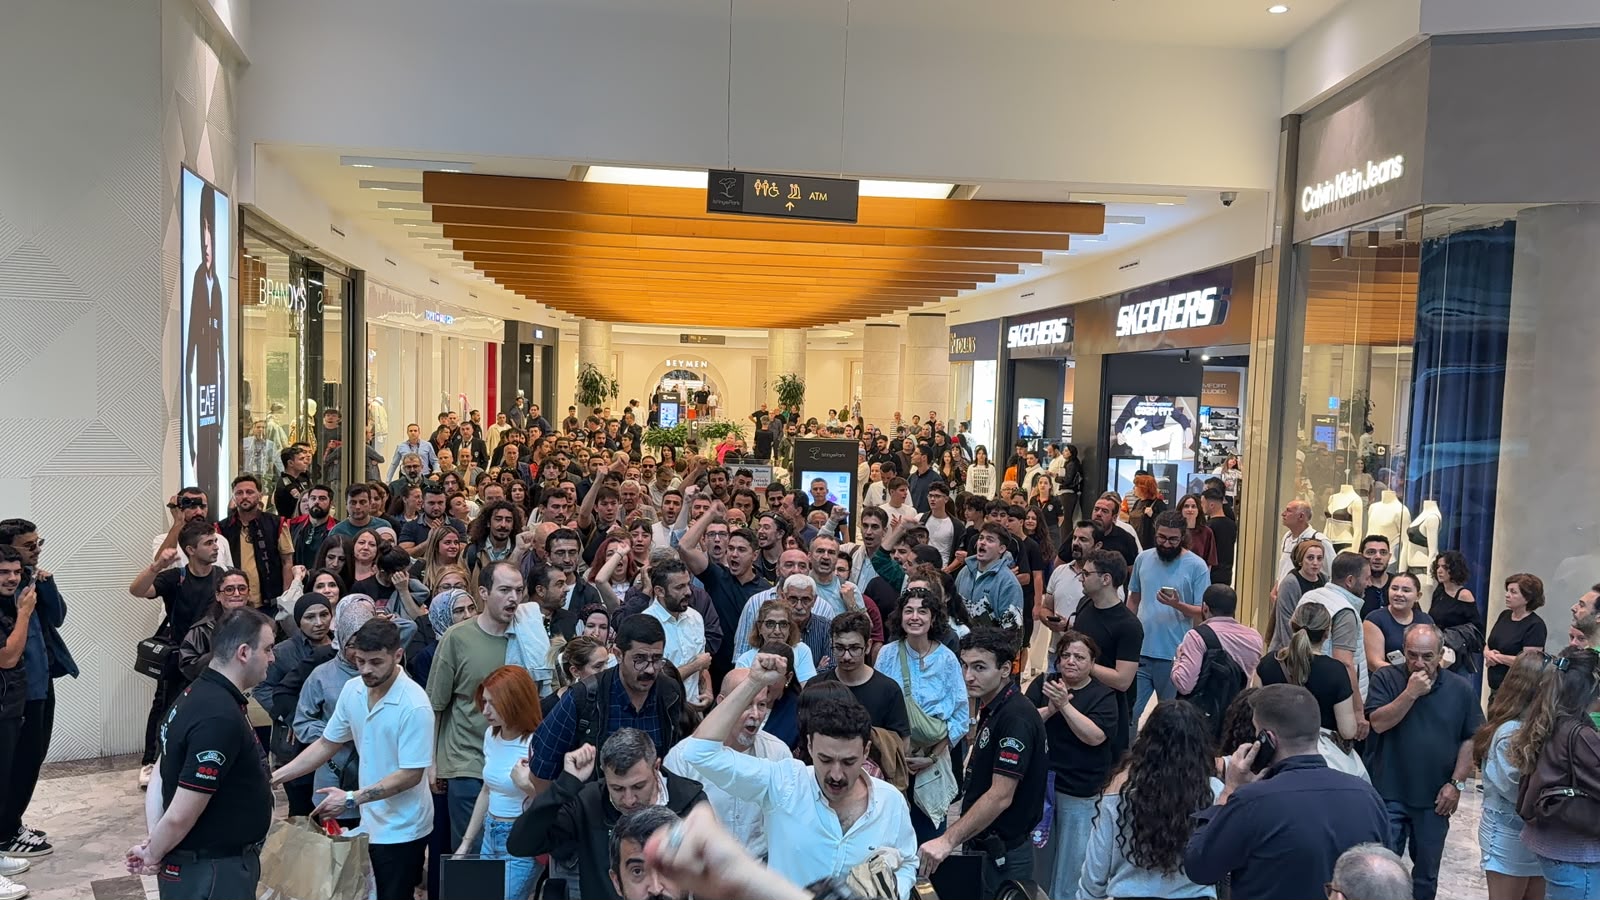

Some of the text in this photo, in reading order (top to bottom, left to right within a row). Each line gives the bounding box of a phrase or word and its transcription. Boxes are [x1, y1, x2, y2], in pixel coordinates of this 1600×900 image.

[809, 192, 828, 201] ATM
[1302, 155, 1404, 212] Calvin Klein Jeans
[1116, 287, 1217, 336] SKECHERS
[1006, 317, 1068, 348] SKECHERS
[665, 359, 708, 368] BEYMEN
